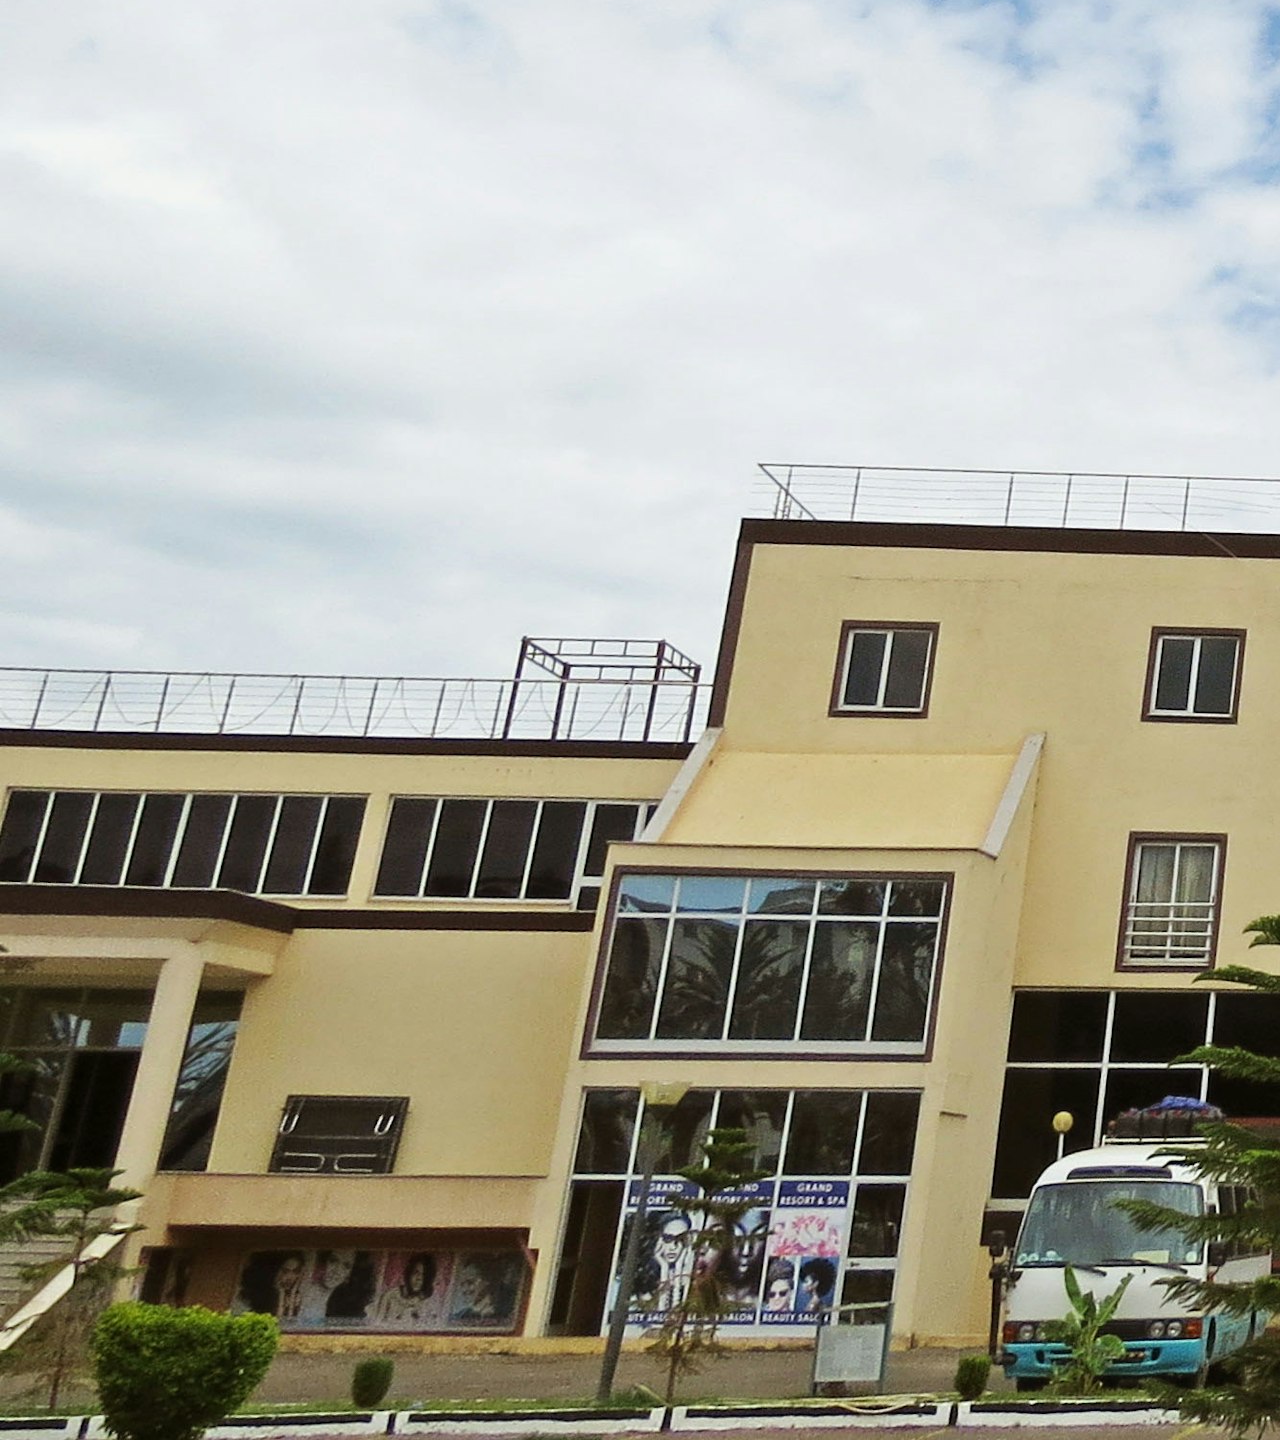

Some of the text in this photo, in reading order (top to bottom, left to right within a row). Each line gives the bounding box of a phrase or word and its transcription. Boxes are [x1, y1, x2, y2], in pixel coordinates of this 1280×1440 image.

[796, 1182, 833, 1193] GRAND
[779, 1195, 817, 1206] RESORT
[817, 1196, 825, 1206] &
[826, 1195, 847, 1206] SPA
[761, 1312, 796, 1323] BEAUTY
